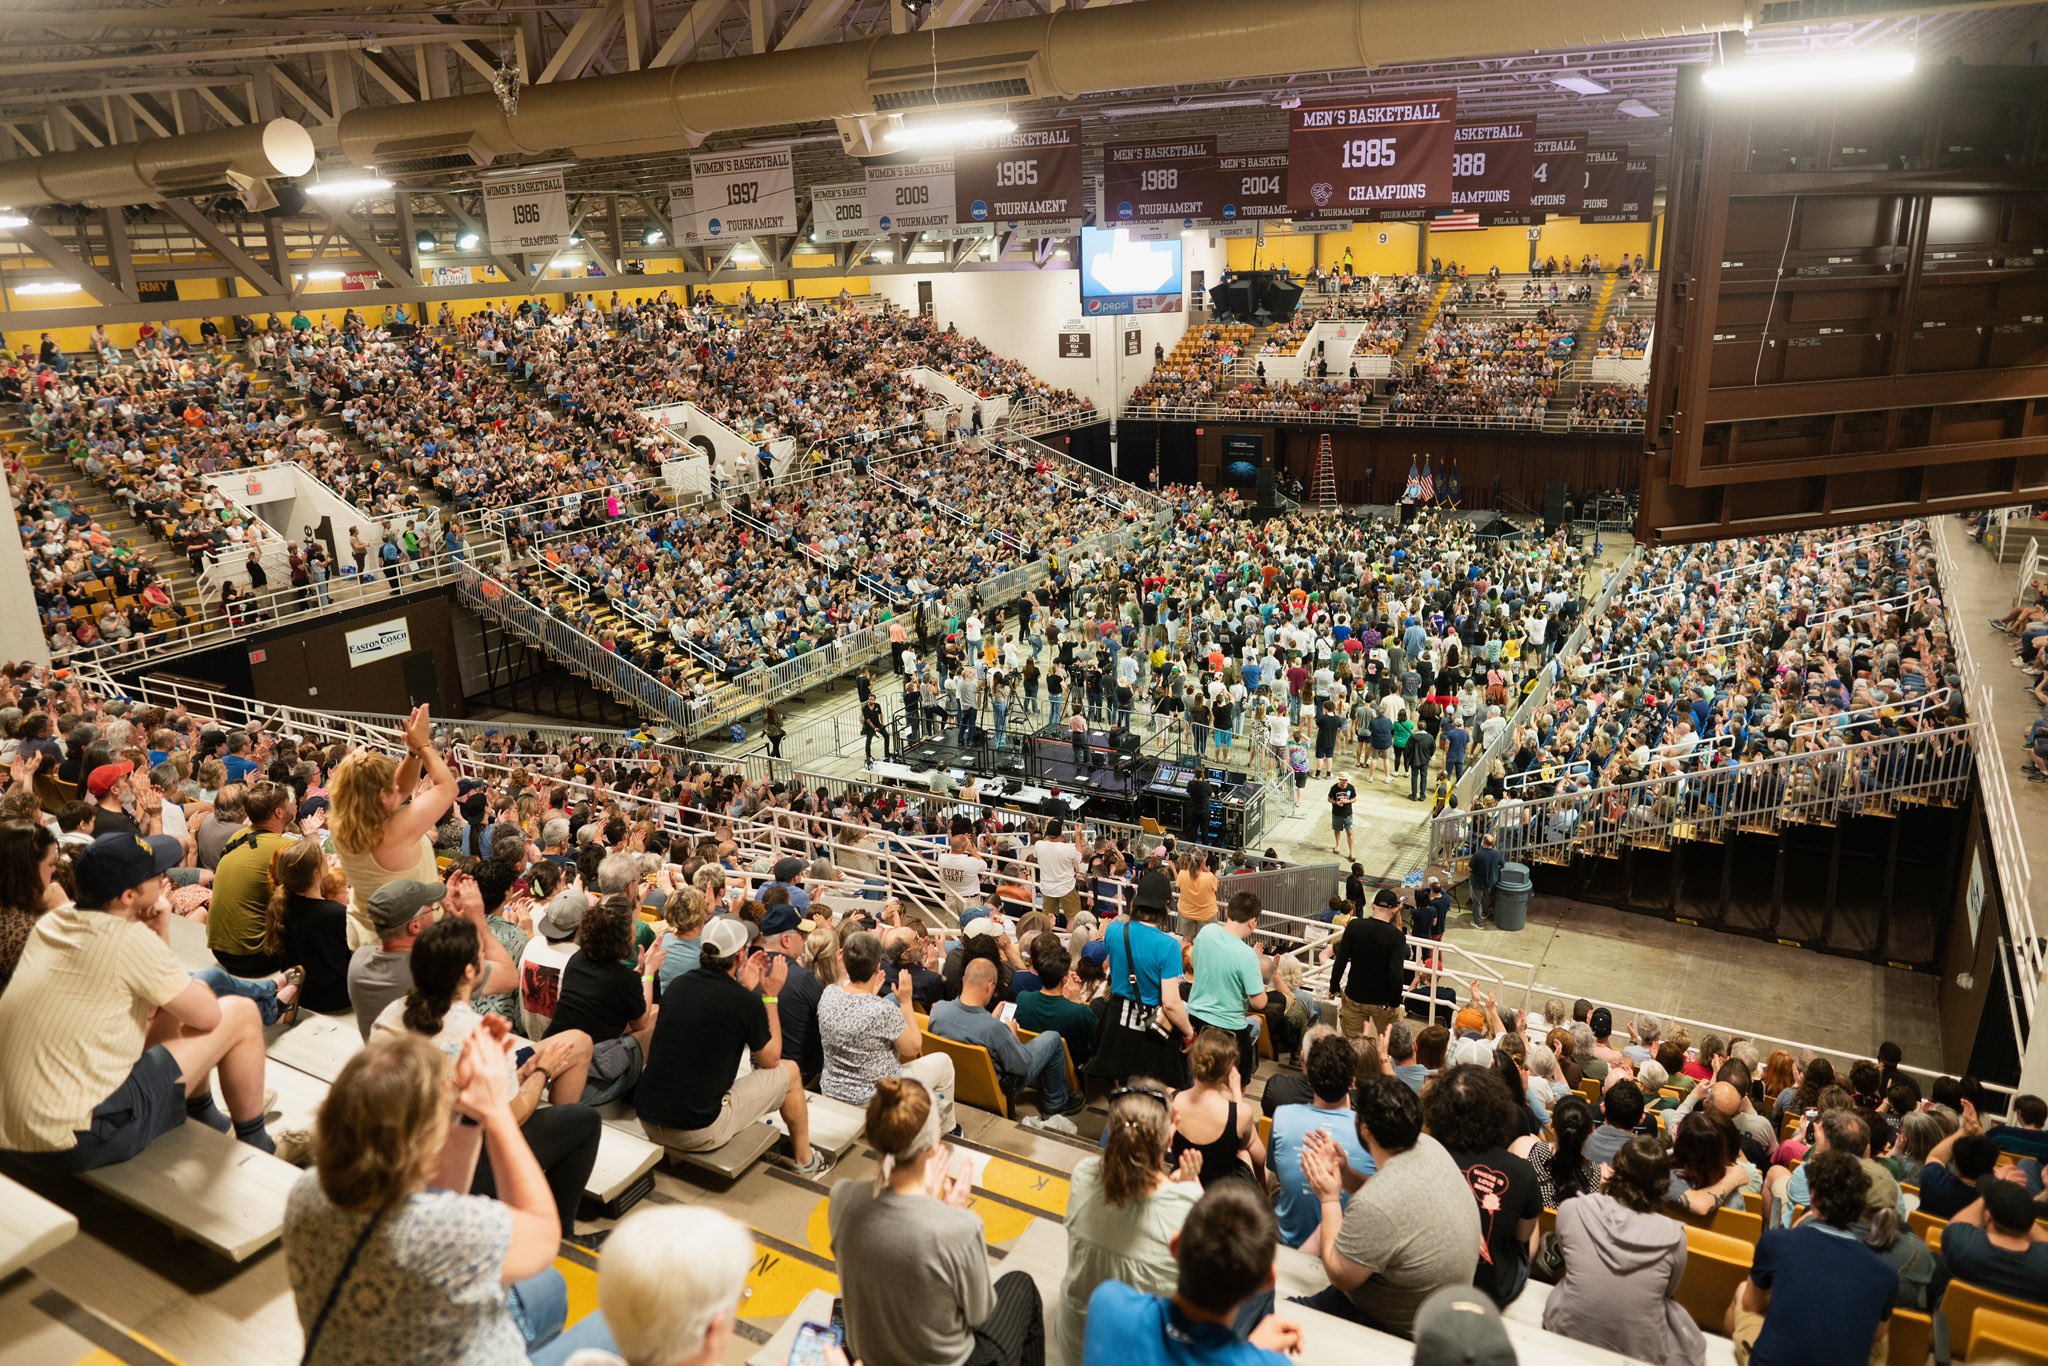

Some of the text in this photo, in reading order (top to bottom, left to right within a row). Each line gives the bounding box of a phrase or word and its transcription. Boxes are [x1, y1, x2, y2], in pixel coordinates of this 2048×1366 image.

[1304, 104, 1440, 126] MEN'S BASKETBALL
[965, 130, 1069, 150] MEN'S BASKETBALL
[1454, 126, 1522, 140] ASKETBALL
[1114, 144, 1206, 160] MEN'S BASKETBALL
[1342, 138, 1396, 168] 1985
[694, 154, 789, 174] WOMEN'S BASKETBALL
[868, 163, 954, 179] WOMEN'S BASKETBALL
[1221, 158, 1246, 169] MEN'S
[1452, 153, 1486, 176] 988
[996, 160, 1038, 186] 1985
[1141, 169, 1178, 190] 1988
[486, 179, 562, 196] WOMEN'S BASKETBALL
[813, 187, 866, 199] WOMEN'S BASKET
[1242, 176, 1280, 195] 2004
[1349, 184, 1426, 200] CHAMPIONS
[727, 182, 758, 205] 1997
[896, 186, 929, 205] 2009
[1451, 190, 1510, 203] HAMPIONS
[513, 204, 540, 224] 1986
[836, 204, 862, 220] 2009
[994, 200, 1067, 215] TOURNAMENT
[1139, 202, 1202, 214] TOURNAMENT
[1319, 208, 1370, 216] TOURNAMENT
[727, 216, 784, 231] TOURNAMENT
[896, 215, 948, 227] TOURNAMENT
[952, 227, 984, 235] CHAMPIONS
[1380, 234, 1386, 243] 9
[1528, 229, 1538, 239] 10
[521, 234, 558, 247] CHAMPIONS
[1258, 238, 1264, 247] 8
[487, 265, 496, 276] 4
[138, 282, 168, 292] RMY
[1103, 301, 1128, 311] pepsi
[314, 516, 340, 577] 1
[349, 632, 406, 653] EASTON COACH
[943, 868, 964, 877] EVENT
